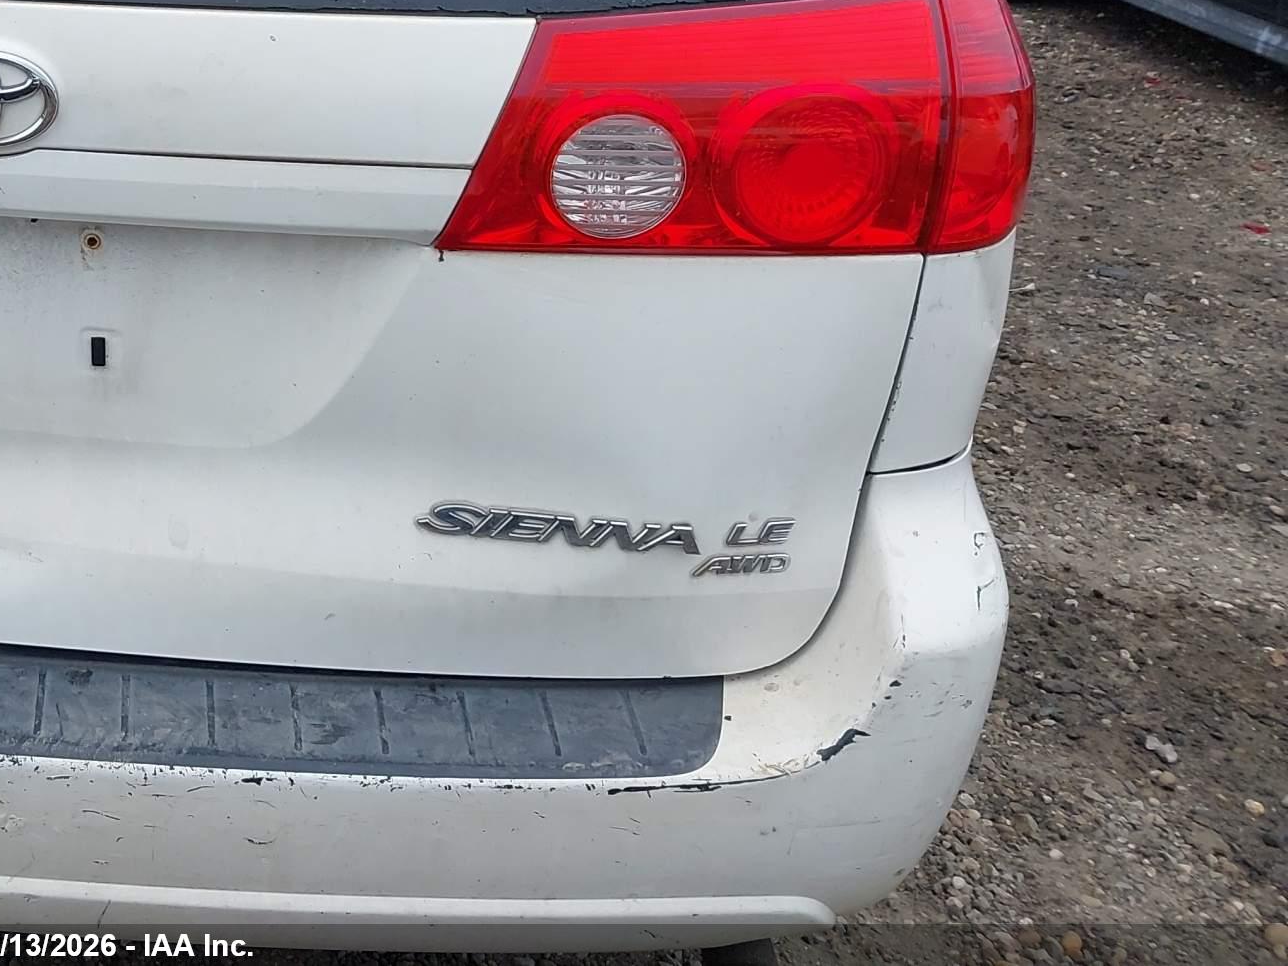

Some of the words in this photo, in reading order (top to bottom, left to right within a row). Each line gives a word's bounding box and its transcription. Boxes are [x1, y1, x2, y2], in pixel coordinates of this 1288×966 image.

[416, 501, 702, 554] SIENNA
[724, 518, 797, 547] LE
[690, 553, 793, 578] AWD
